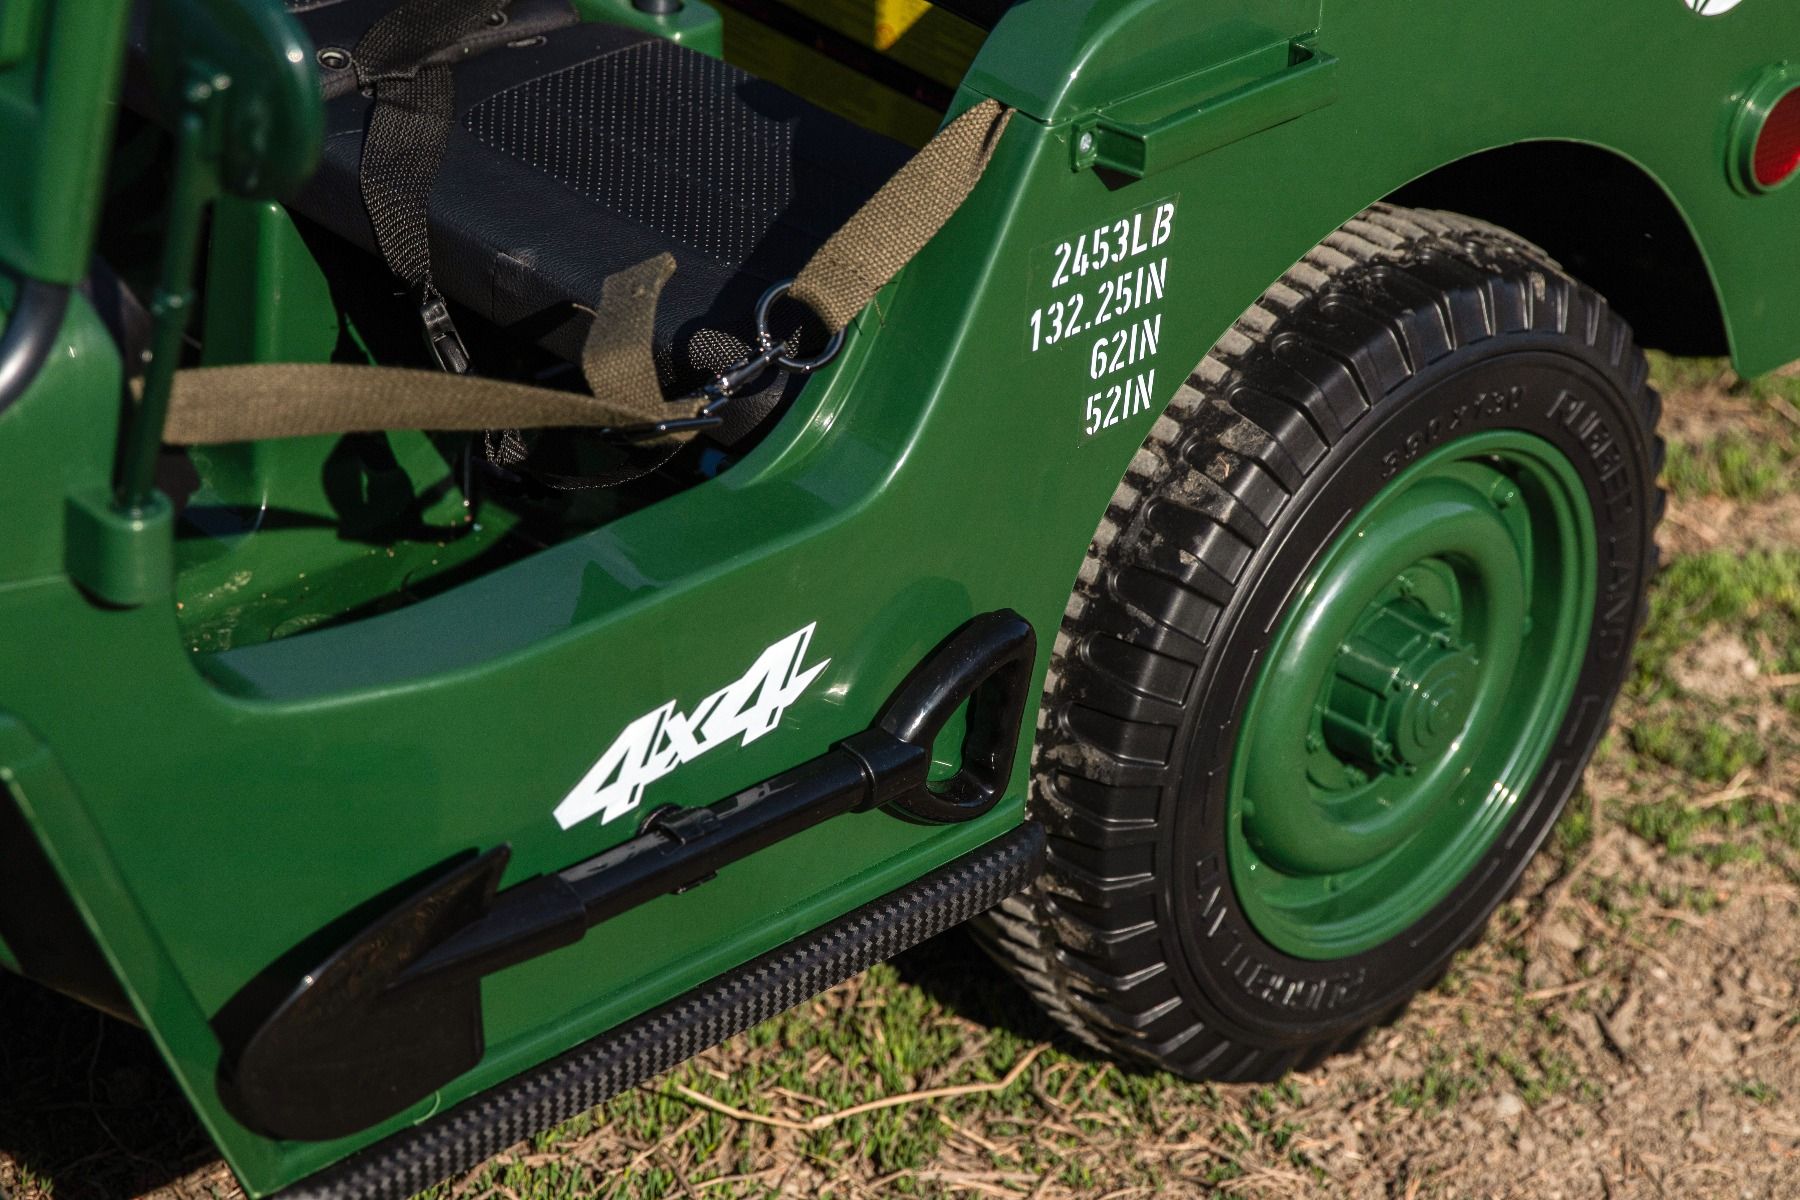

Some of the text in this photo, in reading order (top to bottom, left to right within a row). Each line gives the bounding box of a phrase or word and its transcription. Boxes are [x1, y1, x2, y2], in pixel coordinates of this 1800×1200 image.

[1052, 203, 1175, 288] 2453LB
[1030, 258, 1168, 351] 132.25IN
[1090, 314, 1162, 380] 62IN
[1086, 369, 1155, 435] 52IN
